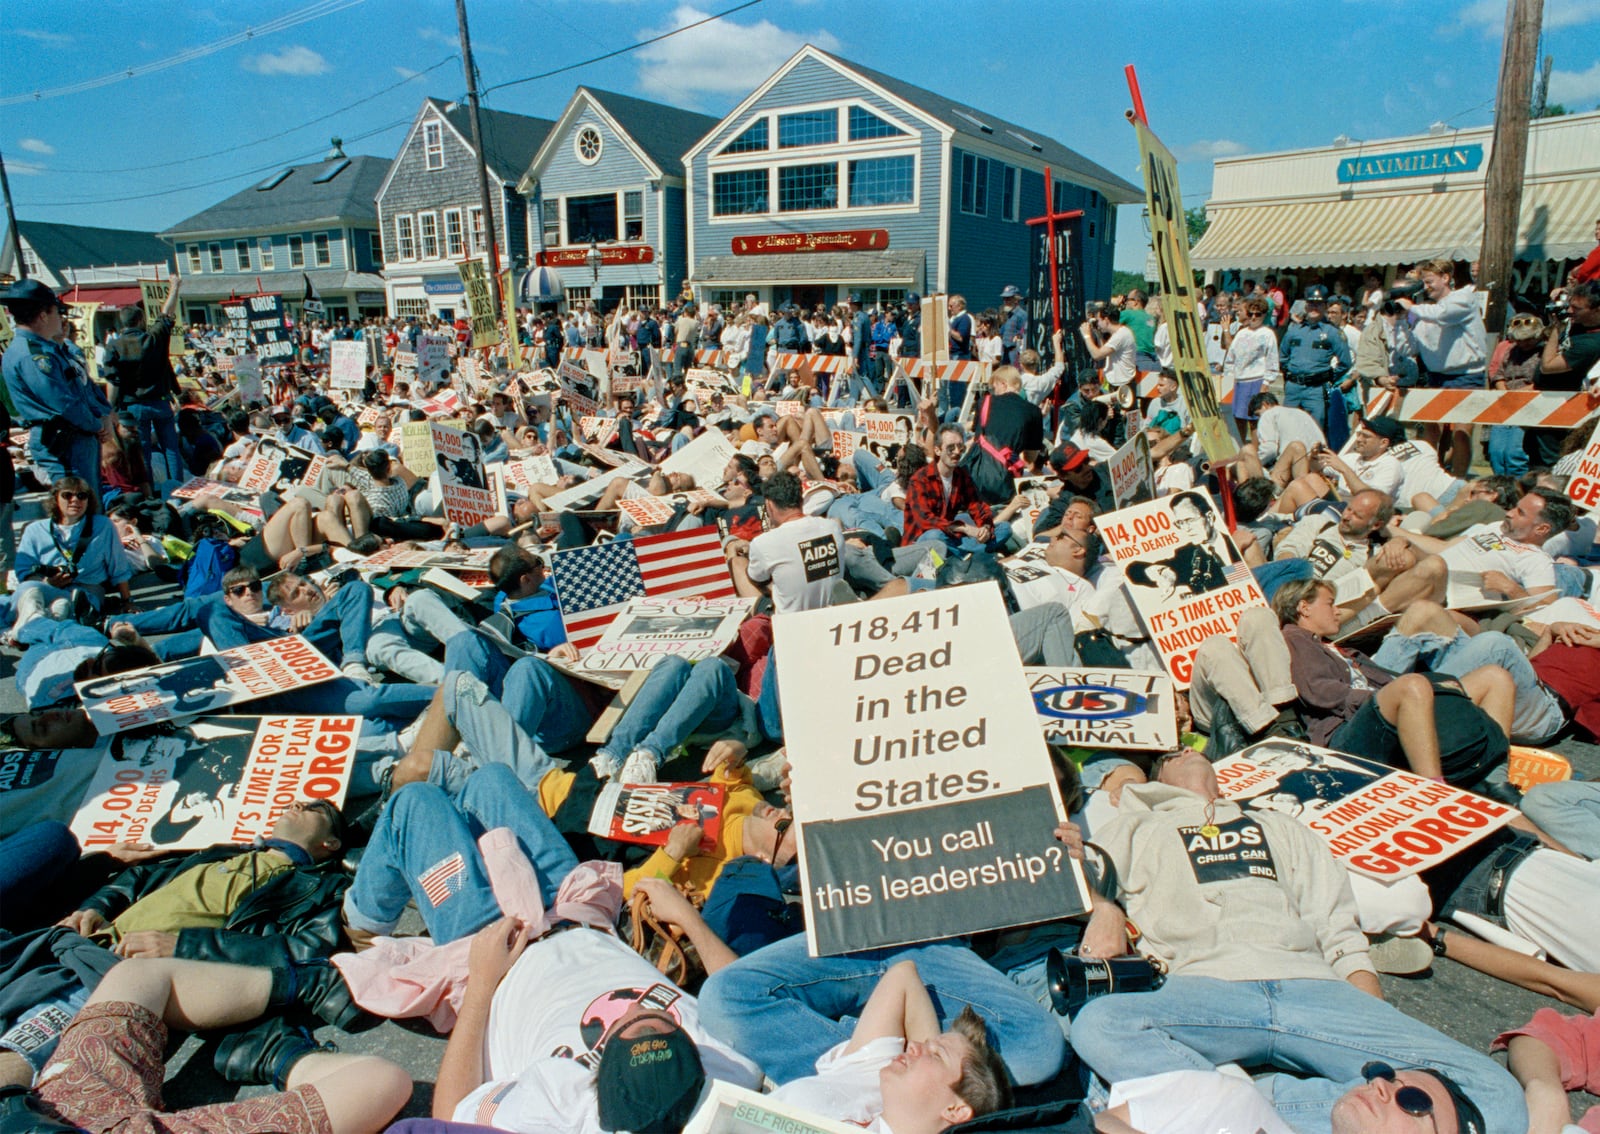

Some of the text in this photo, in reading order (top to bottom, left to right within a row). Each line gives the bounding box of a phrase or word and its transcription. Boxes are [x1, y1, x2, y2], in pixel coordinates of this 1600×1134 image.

[1346, 150, 1469, 176] MAXIMILIAN
[757, 234, 802, 249] Alisson's
[250, 296, 277, 313] DRUG
[256, 340, 293, 363] DEMAND
[445, 497, 495, 513] NATIONAL PLAN
[456, 487, 472, 497] TIME
[473, 489, 485, 500] FOR
[448, 509, 495, 527] GEOR
[804, 542, 836, 563] AIDS
[1116, 532, 1180, 561] AIDS DEATHS
[807, 561, 826, 571] CRISIS
[626, 605, 751, 616] BUSH
[1150, 610, 1178, 634] IT'S
[1179, 598, 1216, 624] TIME
[1215, 589, 1247, 612] FOR
[1248, 583, 1261, 600] A
[635, 630, 708, 640] criminal
[828, 604, 960, 647] 118,411
[1158, 616, 1232, 654] NATIONAL
[267, 636, 335, 681] GEORGE
[596, 641, 688, 653] GUILTY
[853, 641, 952, 682] Dead
[855, 684, 968, 723] in the
[285, 717, 316, 757] PLAN
[1042, 718, 1135, 730] AIDS
[853, 717, 987, 767] United
[0, 751, 25, 790] AIDS
[303, 717, 356, 801] ORGE
[231, 717, 289, 845] IT'S TIME FOR A
[854, 768, 1001, 812] States.
[1234, 769, 1277, 793] DEATHS
[122, 767, 168, 845] AIDS DEATHS
[1322, 794, 1369, 829] TIME
[1368, 781, 1409, 807] FOR
[1400, 774, 1424, 786] A
[1401, 784, 1459, 816] PLAN
[871, 820, 994, 863] You call
[1187, 826, 1262, 852] AIDS
[1350, 794, 1510, 875] GEORGE
[1196, 850, 1267, 865] CRISIS CAN
[1248, 865, 1276, 878] END.
[815, 846, 1063, 911] this leadership?
[736, 1105, 770, 1125] SELF
